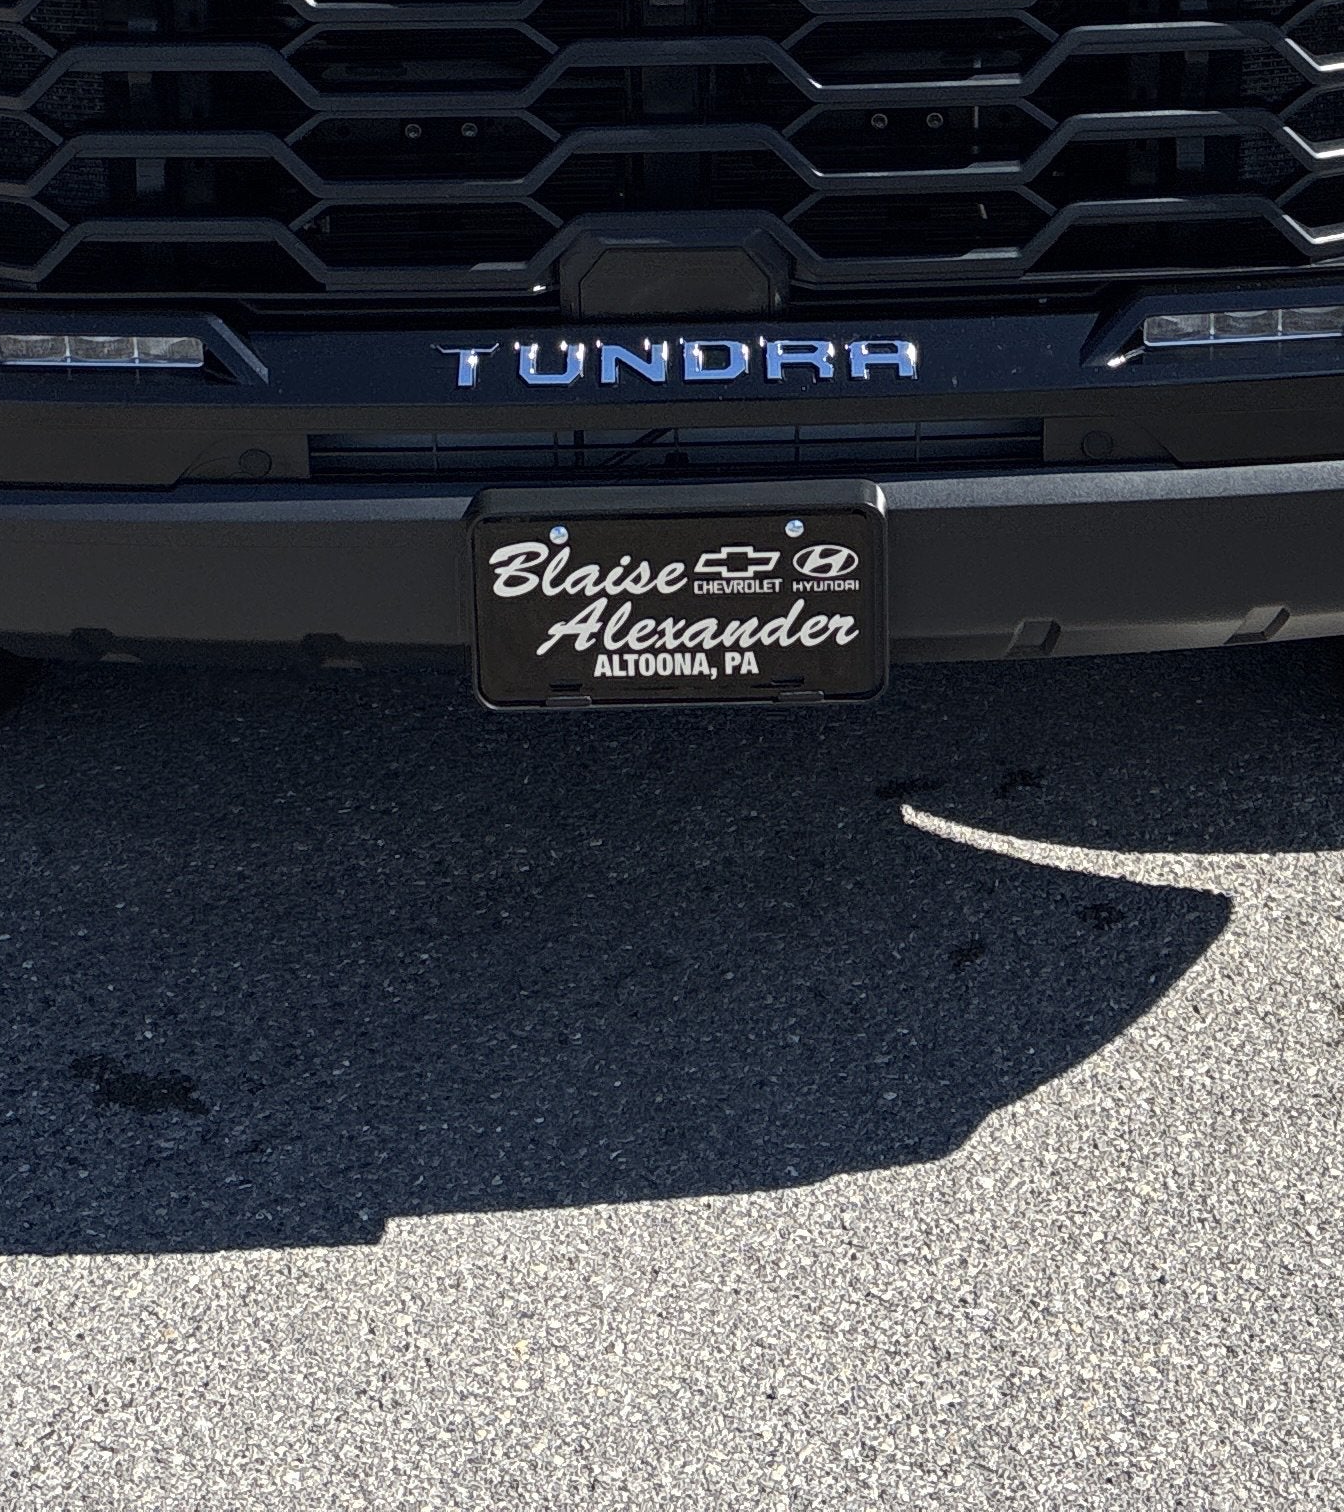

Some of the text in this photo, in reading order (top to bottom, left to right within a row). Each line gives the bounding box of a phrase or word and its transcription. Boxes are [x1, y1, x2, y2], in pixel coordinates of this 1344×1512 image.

[430, 335, 919, 388] TUNDRA
[488, 541, 688, 597] Blaise
[693, 578, 860, 594] CHEVROLET HYUNDAI
[536, 597, 860, 656] Alexander
[593, 651, 760, 681] ALTOONA, PA
